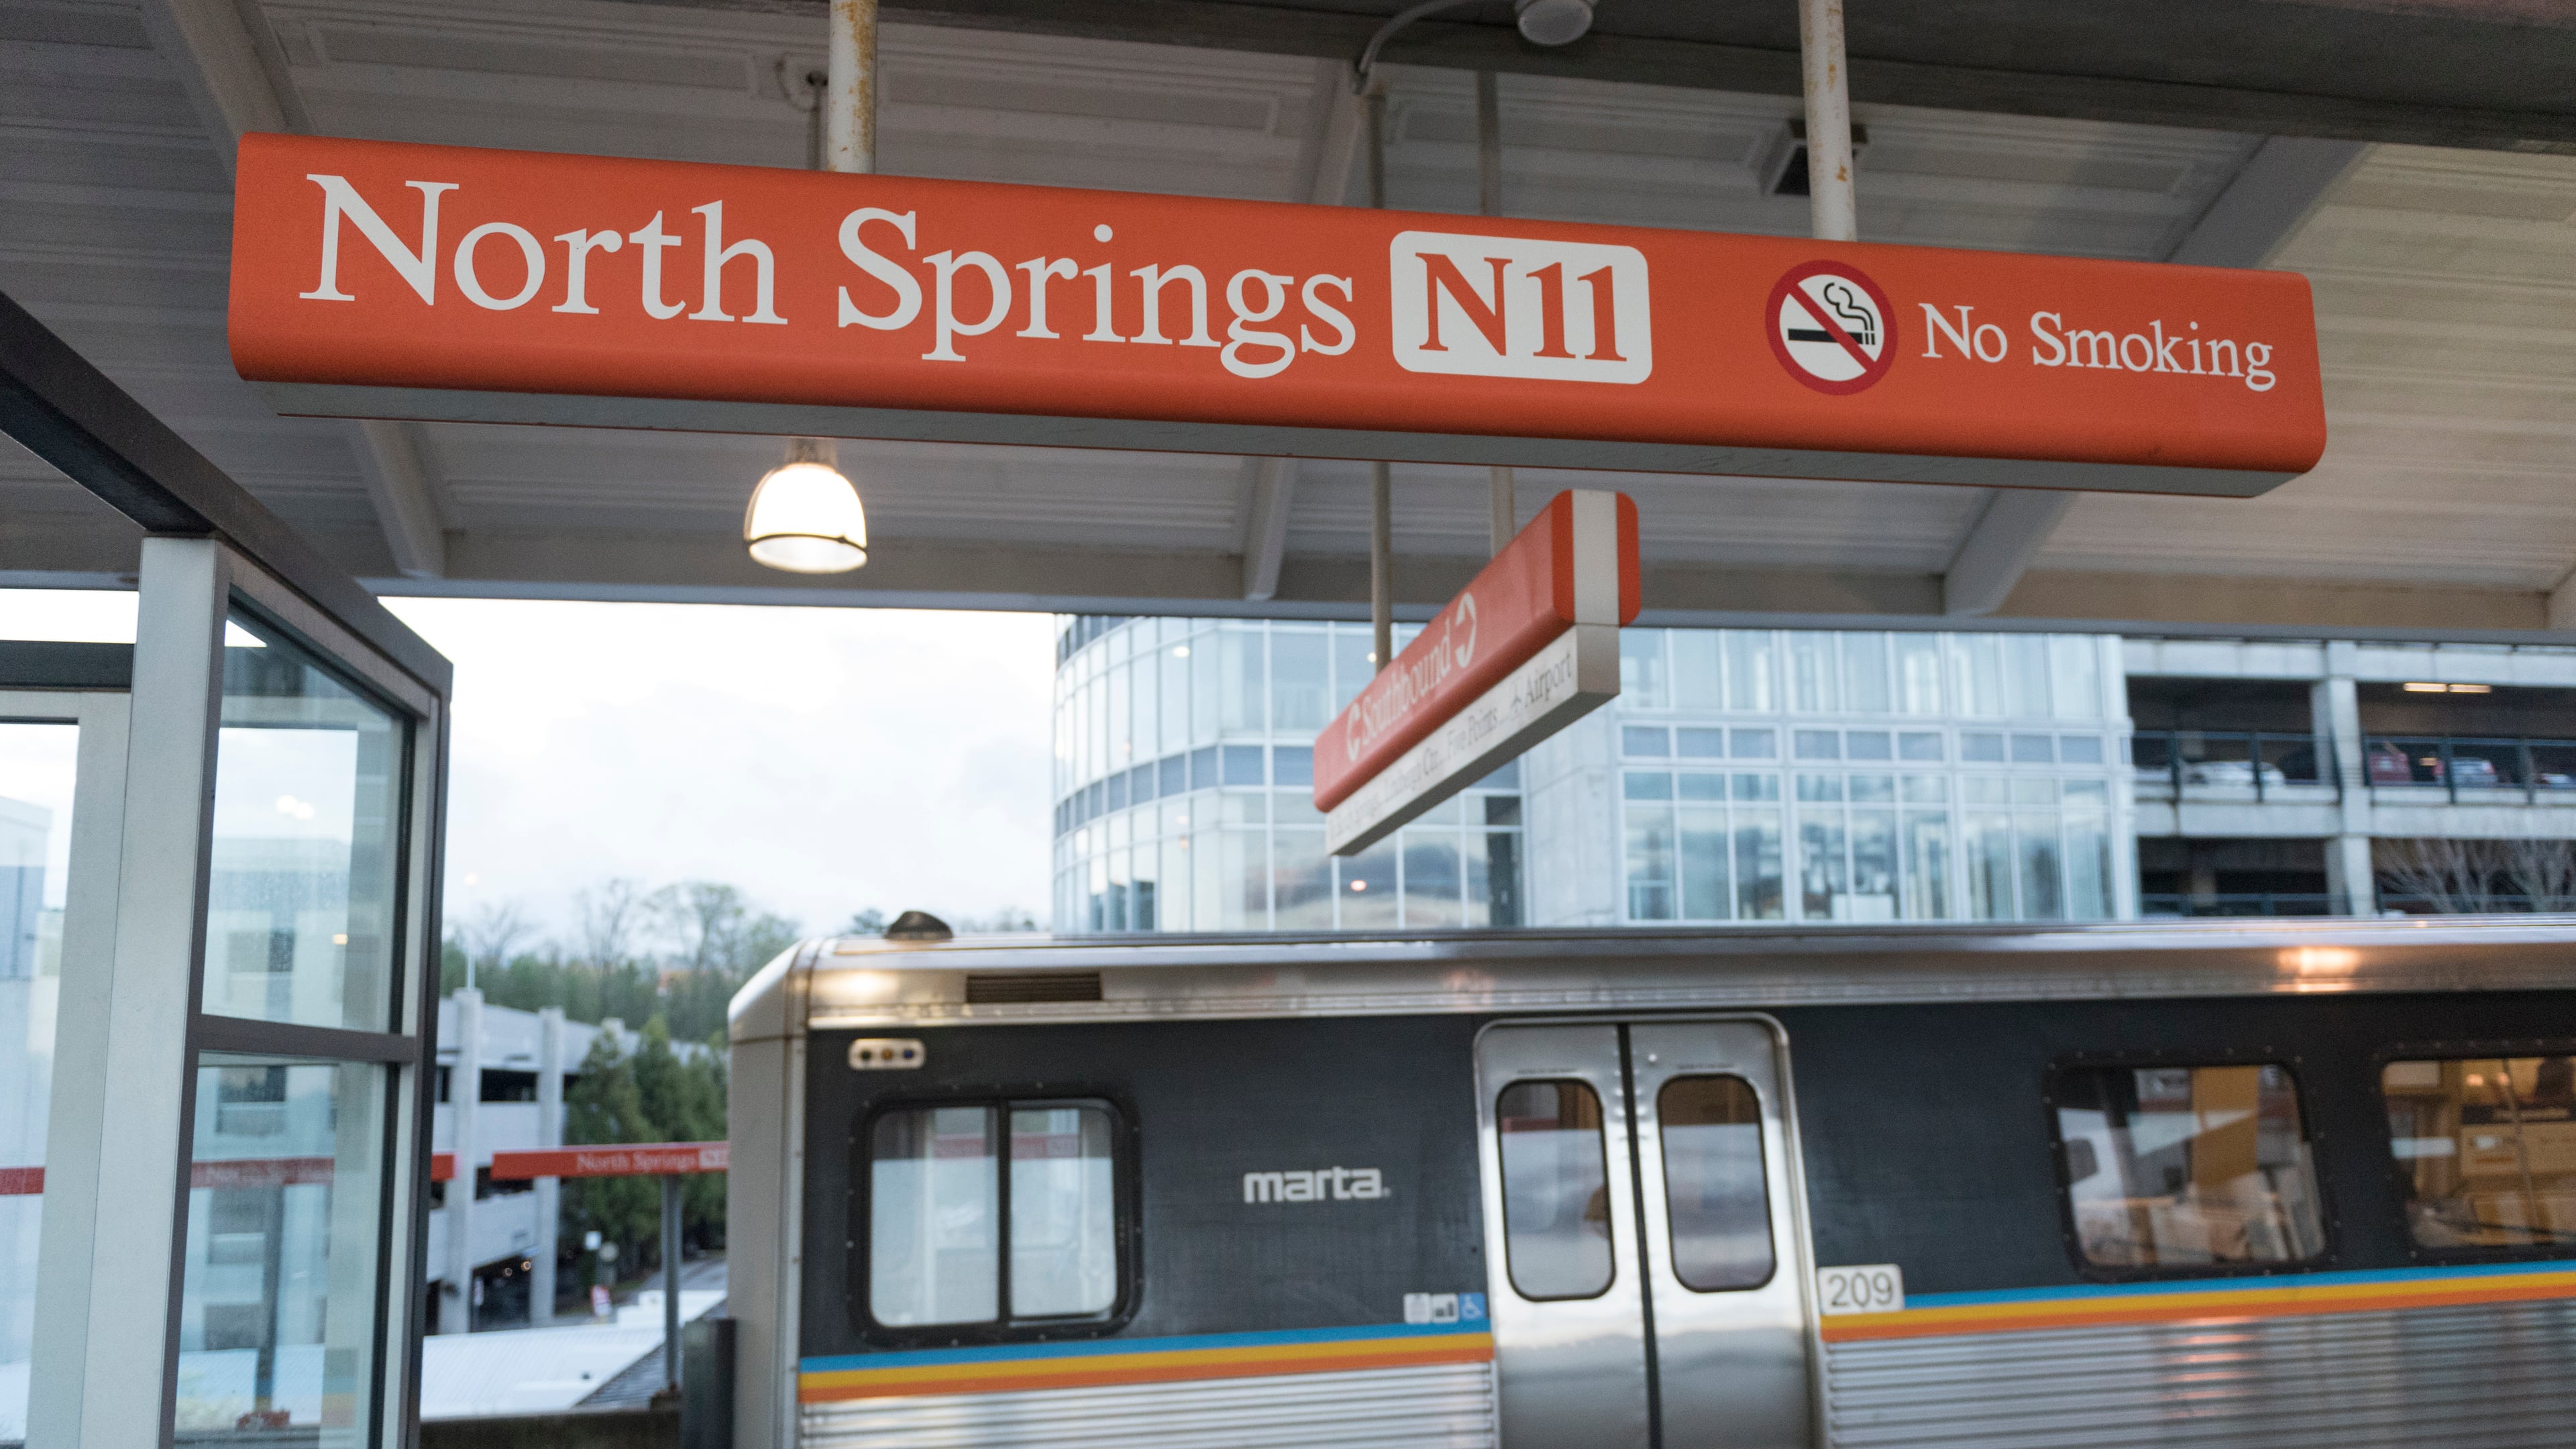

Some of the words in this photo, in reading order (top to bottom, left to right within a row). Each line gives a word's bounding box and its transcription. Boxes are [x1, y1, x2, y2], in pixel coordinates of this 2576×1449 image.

[299, 174, 788, 325] North
[838, 207, 1356, 380] Springs
[1415, 252, 1627, 362] N11
[1918, 303, 2008, 364] No
[2030, 311, 2276, 392] Smoking
[1362, 616, 1451, 745] Southbound
[1523, 650, 1571, 708] Airport
[577, 1152, 629, 1172] North
[633, 1150, 696, 1174] Springs
[1827, 1271, 1894, 1308] 209
